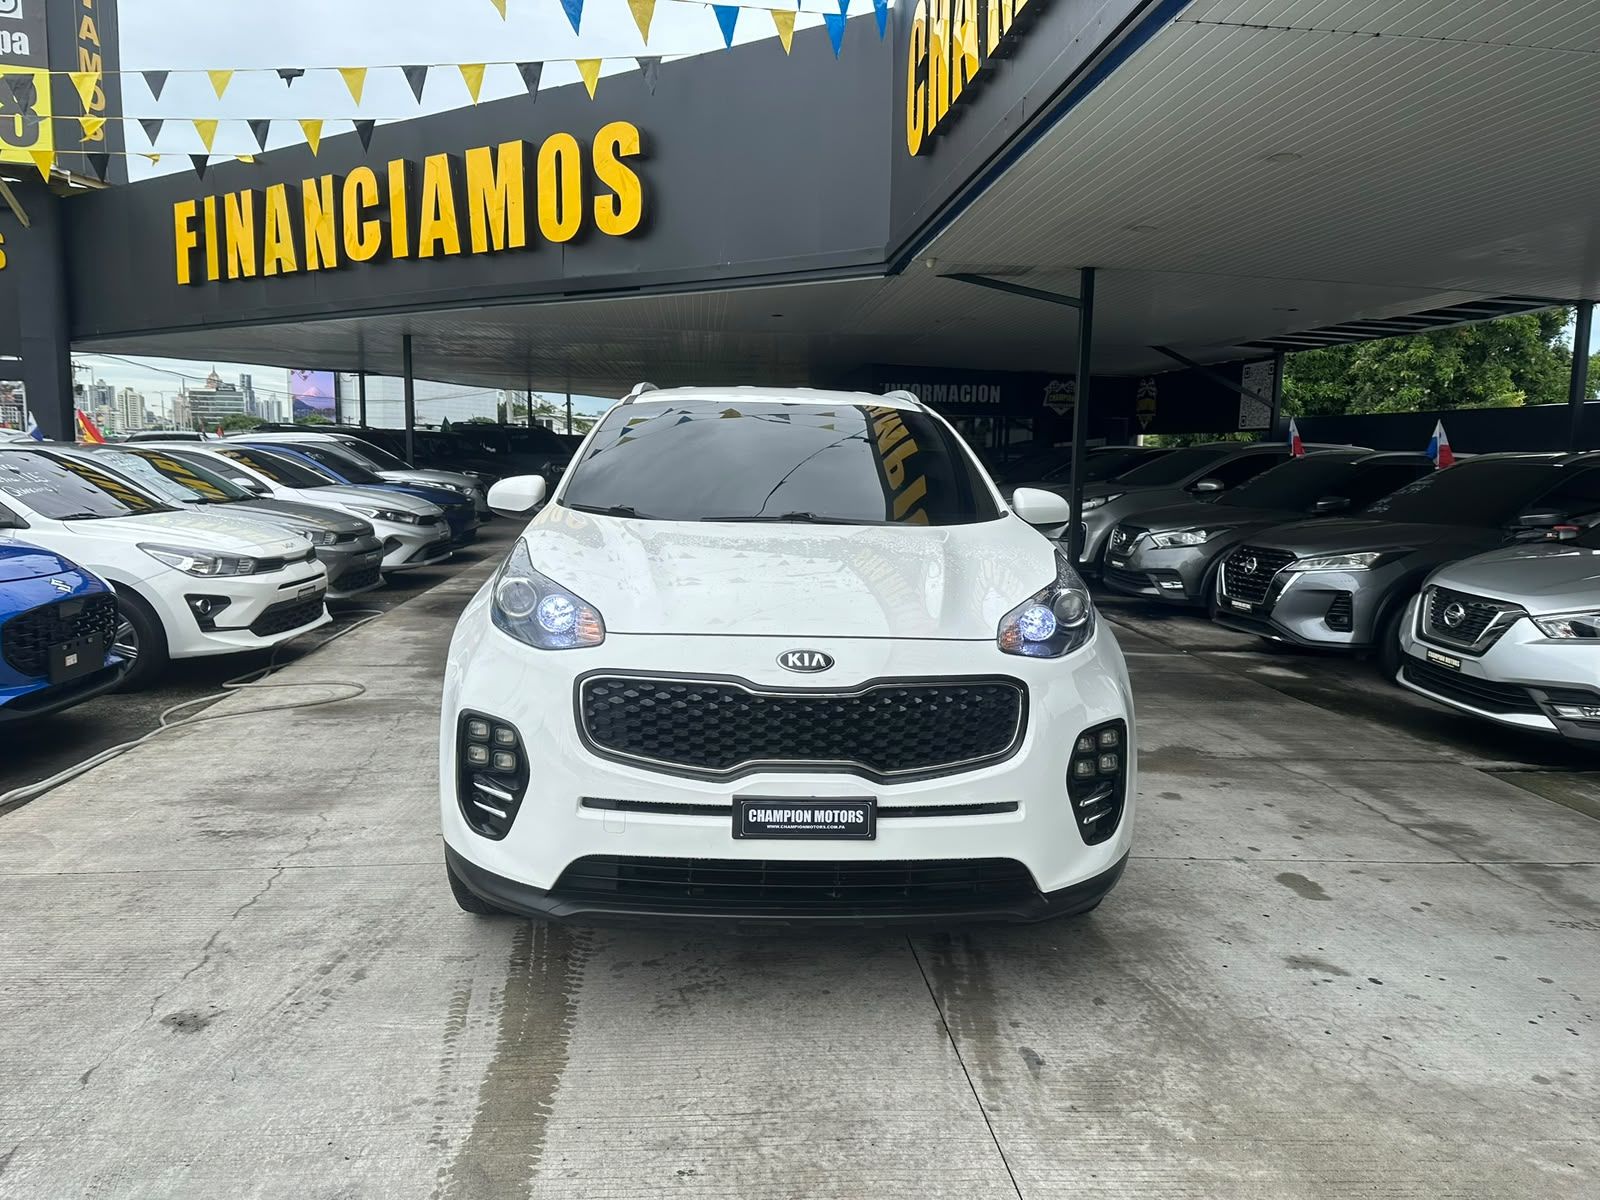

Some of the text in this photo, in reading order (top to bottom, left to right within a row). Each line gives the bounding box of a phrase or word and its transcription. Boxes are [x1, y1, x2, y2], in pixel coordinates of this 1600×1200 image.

[173, 121, 643, 285] FINANCIAMOS
[787, 653, 826, 667] KIA
[748, 809, 864, 823] CHAMPION MOTORS
